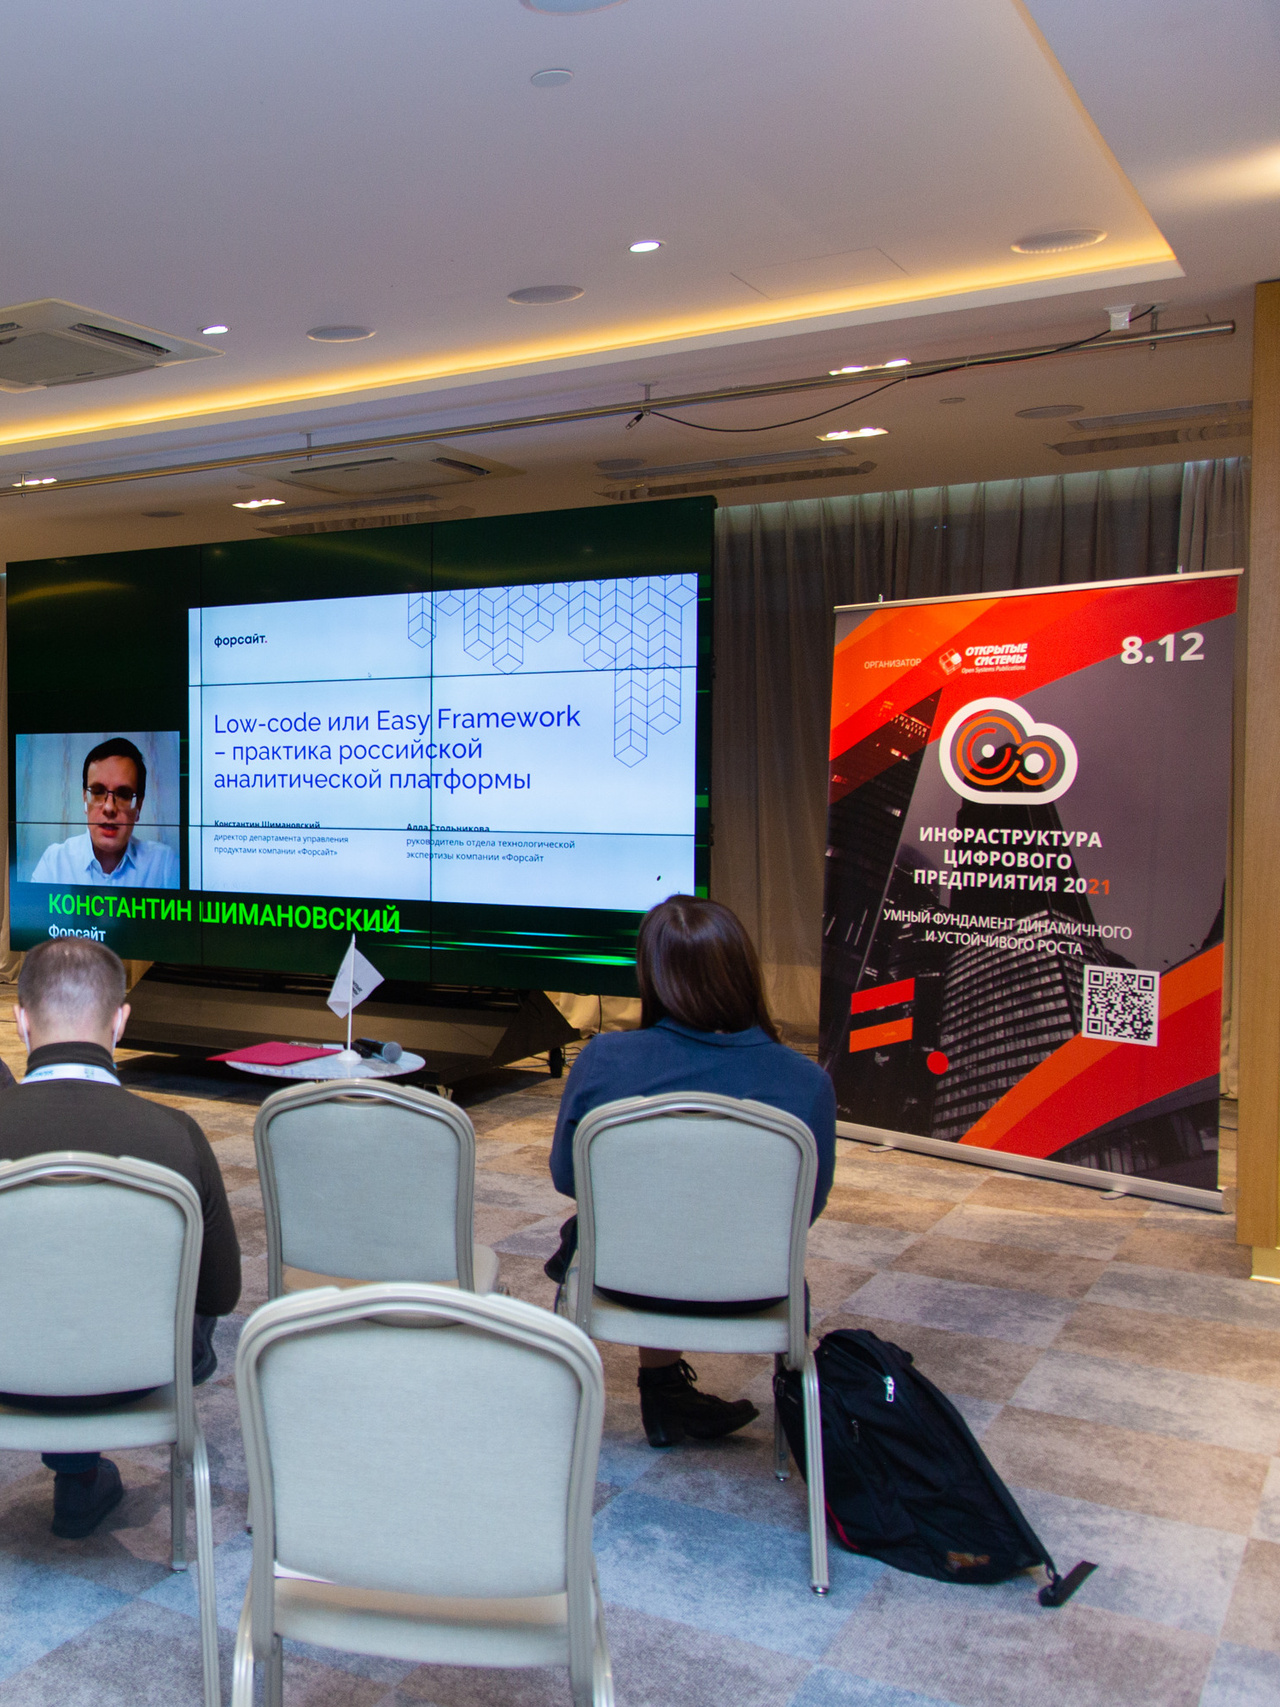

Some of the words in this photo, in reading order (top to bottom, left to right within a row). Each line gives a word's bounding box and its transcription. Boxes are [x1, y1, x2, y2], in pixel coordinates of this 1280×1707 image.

[965, 643, 1028, 656] ОТКРЫТЫЕ
[1120, 631, 1205, 665] 8.12
[864, 658, 922, 669] ОРГАНИЗАТОР
[974, 654, 1028, 666] СИСТЕМЫ
[995, 664, 1026, 672] Publications
[214, 712, 321, 733] Low-code
[328, 714, 370, 731] или
[377, 710, 431, 735] Easy
[438, 704, 581, 729] Framework
[232, 743, 332, 765] практика
[339, 738, 483, 764] российской
[214, 768, 382, 789] аналитической
[390, 767, 531, 794] платформы
[214, 820, 260, 828] Константин
[261, 820, 321, 829] Шимановский
[406, 823, 429, 832] Алла
[430, 824, 490, 832] Стольникова
[214, 834, 248, 842] директор
[249, 834, 301, 843] департамента
[303, 836, 349, 844] управления
[406, 837, 464, 848] руководитель
[466, 839, 496, 847] отдела
[498, 840, 576, 849] технологической
[919, 827, 1103, 848] ИНФРАСТРУКТУРА
[214, 846, 257, 855] продуктами
[297, 847, 338, 857] «Форсайт»
[406, 852, 454, 861] экспертизы
[455, 853, 500, 862] компании
[501, 853, 545, 863] «Форсайт
[944, 849, 1072, 870] ЦИФРОВОГО
[913, 869, 1058, 892] ПРЕДПРИЯТИЯ
[1063, 877, 1110, 895] 2021
[48, 893, 192, 922] КОНСТАНТИН
[199, 900, 401, 934] ШИМАНОВСКИЙ
[48, 923, 107, 942] Форсайт
[882, 908, 931, 924] УМНЫЙ
[932, 911, 1016, 930] ФУНДАМЕНТ
[1017, 917, 1132, 940] ДИНАМИЧНОГО
[925, 930, 936, 941] И
[937, 930, 1035, 951] УСТОЙЧИВОГО
[1038, 939, 1084, 956] РОСТА
